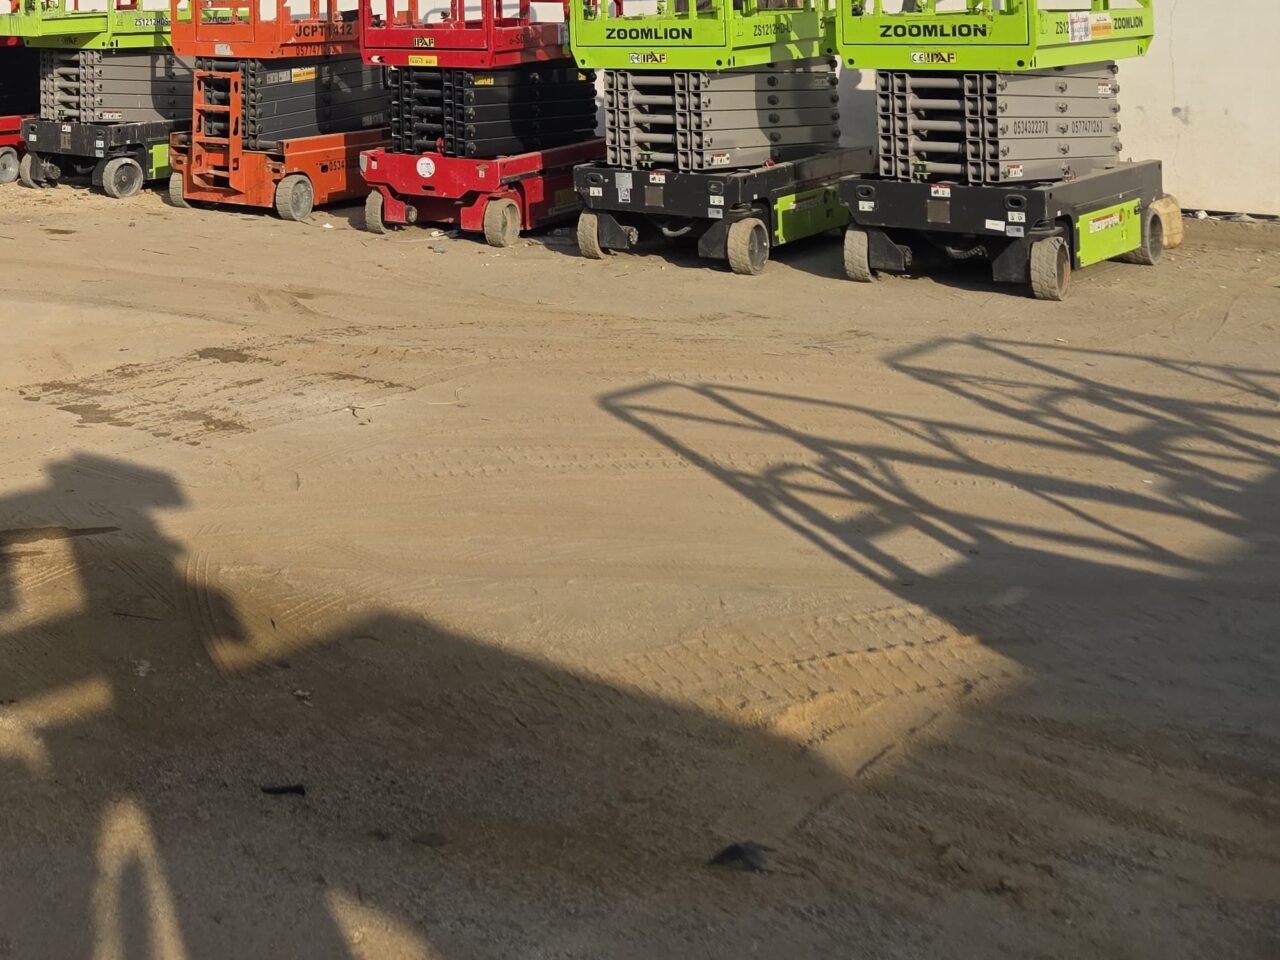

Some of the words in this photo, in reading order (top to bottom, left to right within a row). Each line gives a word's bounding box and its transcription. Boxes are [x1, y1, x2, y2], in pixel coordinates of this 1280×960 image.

[1113, 16, 1143, 30] ZOOMLION
[295, 24, 353, 38] JCPT1412
[606, 28, 692, 39] ZOOMLION
[880, 24, 987, 37] ZOOMLION
[413, 36, 435, 48] IPAF
[642, 51, 666, 63] IPAF
[926, 52, 955, 63] IPAF
[1013, 120, 1049, 135] 0534322378
[1071, 120, 1103, 133] 0577471263
